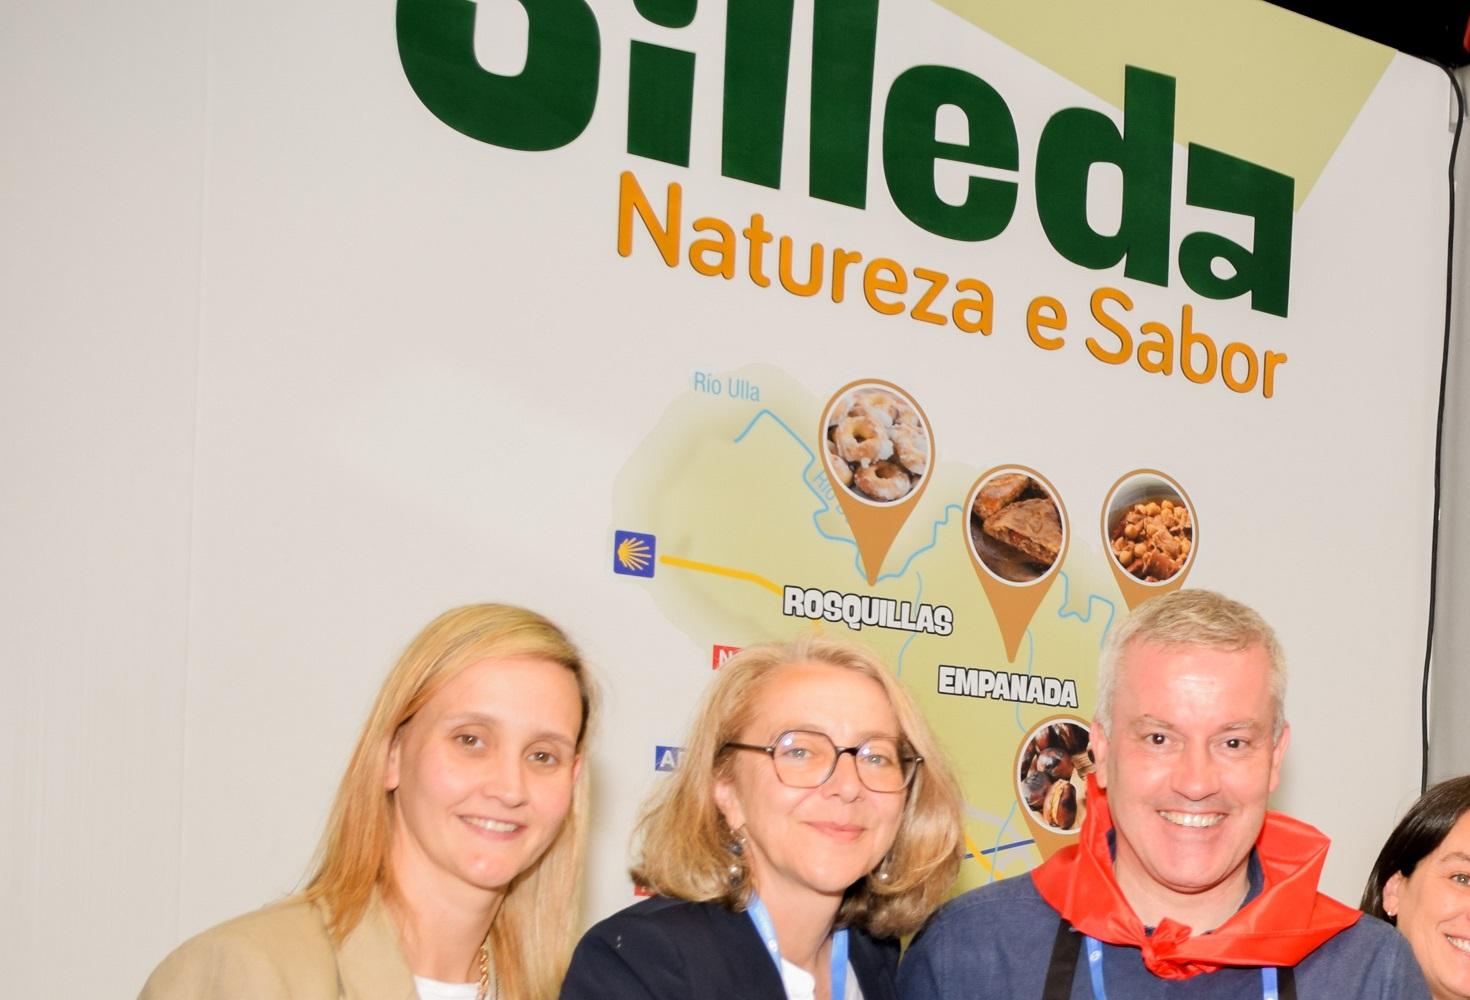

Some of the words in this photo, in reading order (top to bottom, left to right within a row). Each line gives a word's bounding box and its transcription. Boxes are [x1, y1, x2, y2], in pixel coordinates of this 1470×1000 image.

[616, 170, 994, 336] Natureza
[1026, 295, 1067, 351] e
[1085, 286, 1287, 399] Sabor
[694, 372, 722, 395] Río
[727, 377, 760, 402] Ulla
[783, 585, 953, 635] ROSQUILLAS
[938, 665, 1078, 708] EMPANADA
